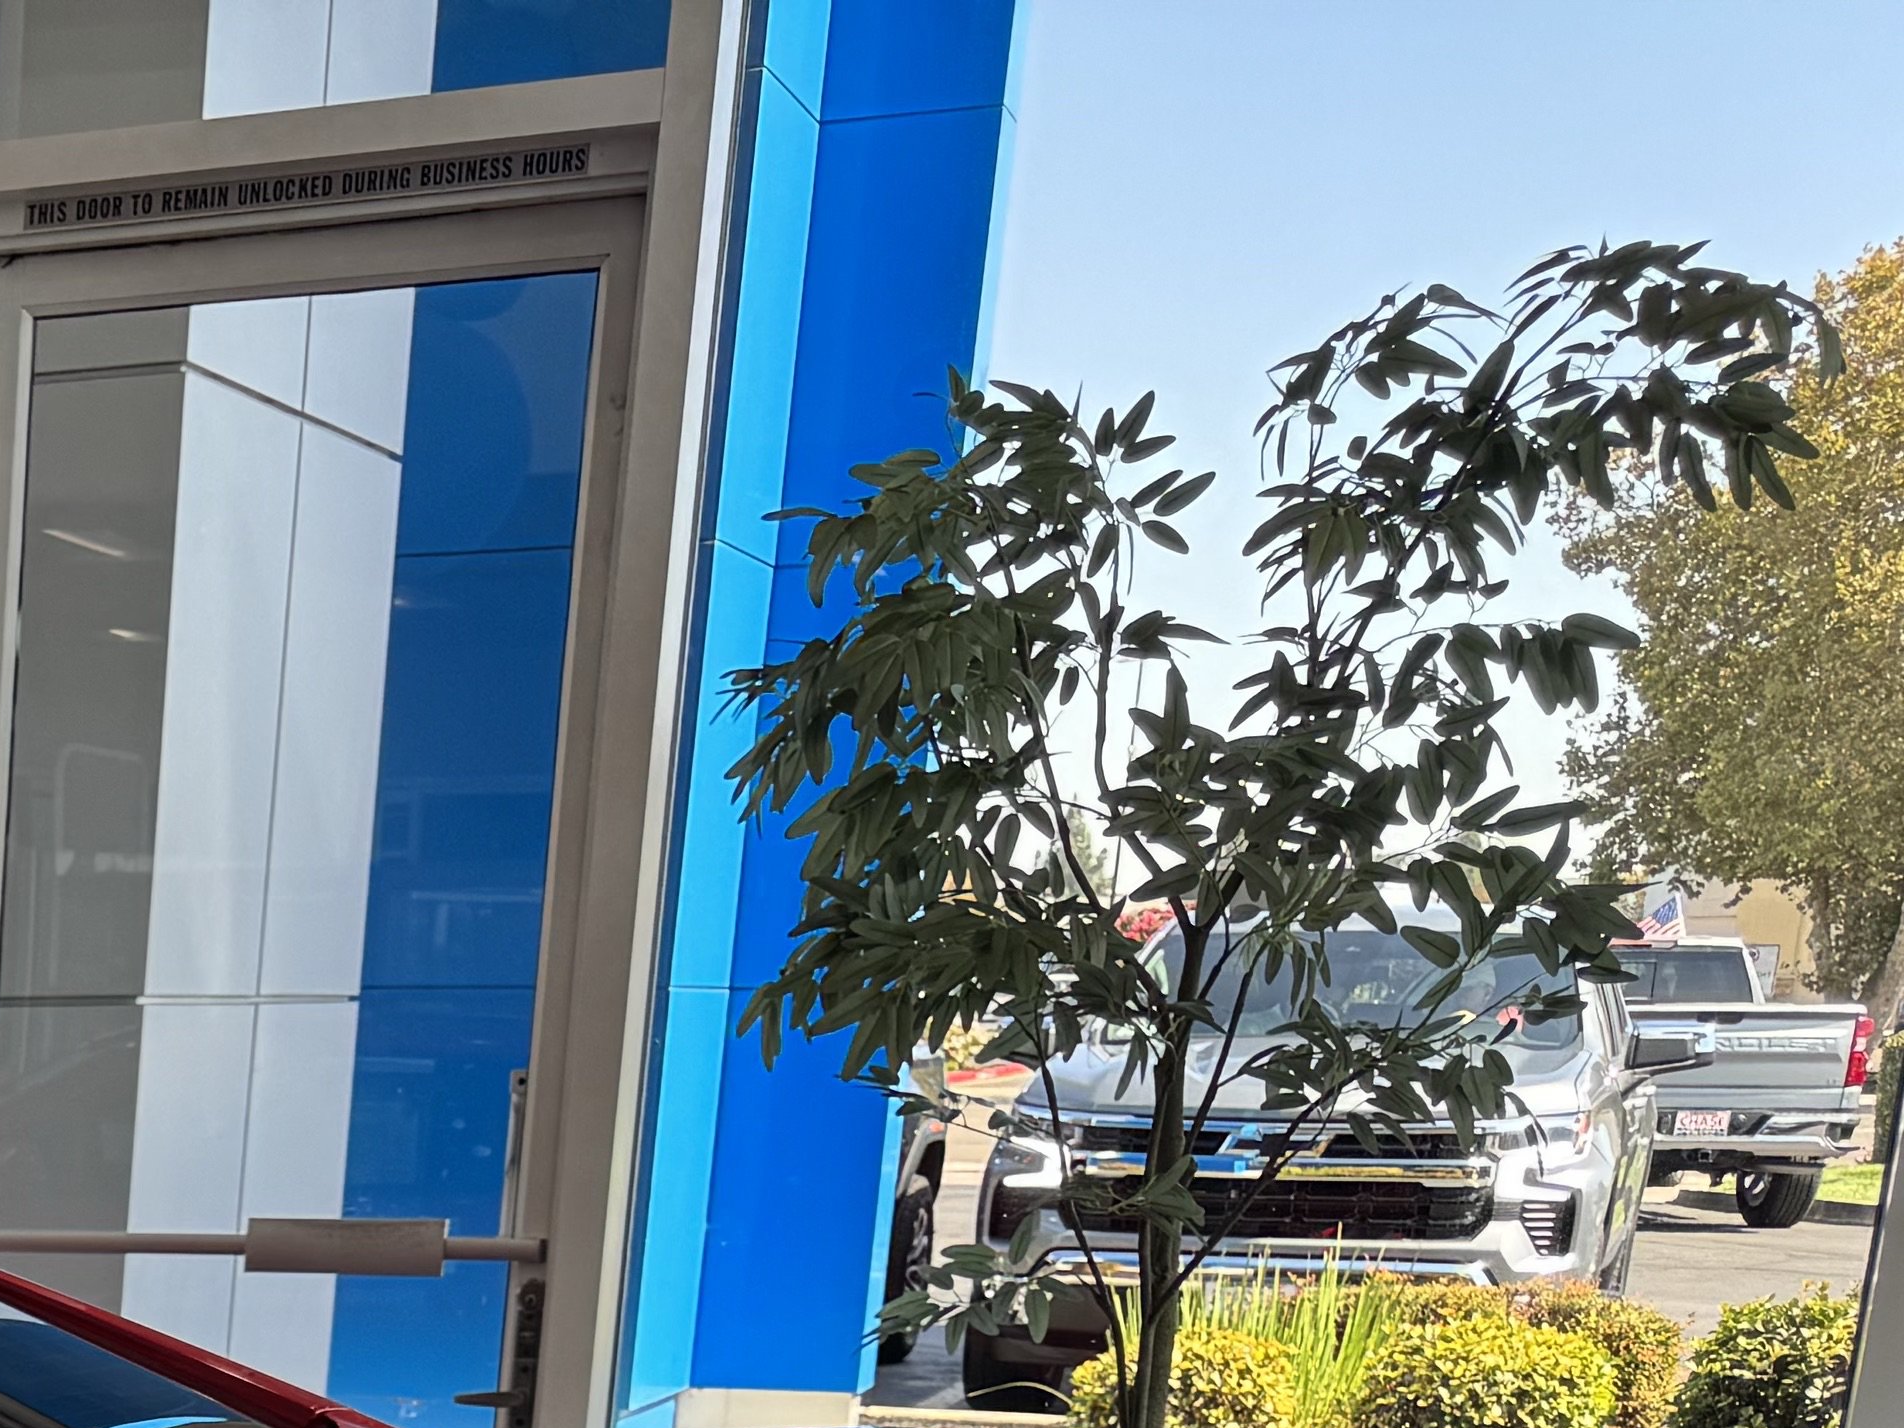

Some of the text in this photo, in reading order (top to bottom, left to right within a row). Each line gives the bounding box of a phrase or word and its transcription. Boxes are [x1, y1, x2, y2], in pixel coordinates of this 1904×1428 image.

[27, 148, 587, 225] THIS DOOR TO REMAIN UNLOCKED DURING BUSINESS HOURS
